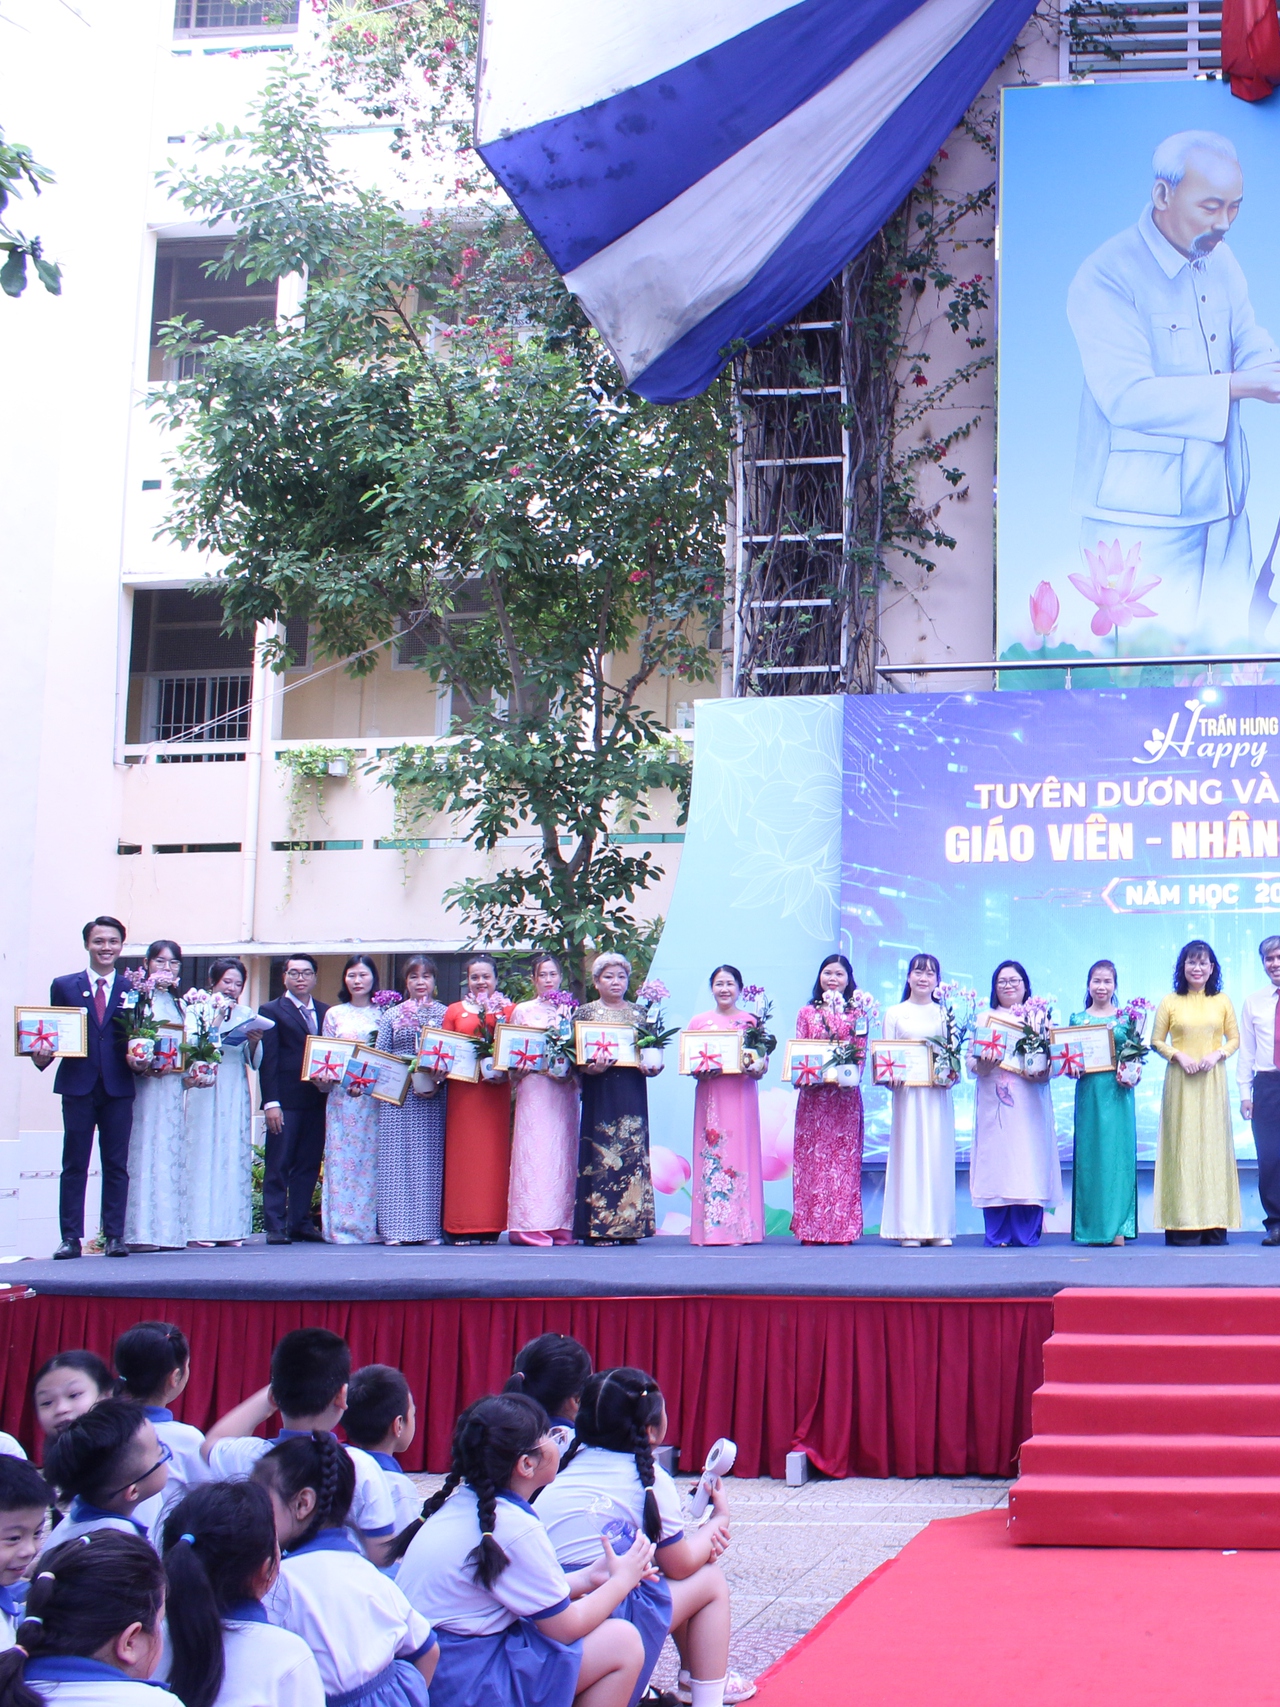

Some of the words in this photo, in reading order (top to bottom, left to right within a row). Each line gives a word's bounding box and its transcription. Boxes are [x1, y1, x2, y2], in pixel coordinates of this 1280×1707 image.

[1132, 702, 1267, 769] Happy
[1198, 713, 1237, 736] TRẦN
[1240, 717, 1278, 736] HƯNG
[974, 775, 1087, 810] TUYÊN
[1097, 776, 1222, 808] DƯƠNG
[1231, 772, 1280, 804] VÀ
[944, 814, 1035, 864] GIÁO
[1047, 813, 1134, 861] VIÊN
[1171, 810, 1280, 860] NHÂN
[1125, 880, 1180, 906] NĂM
[1188, 883, 1240, 910] HỌC
